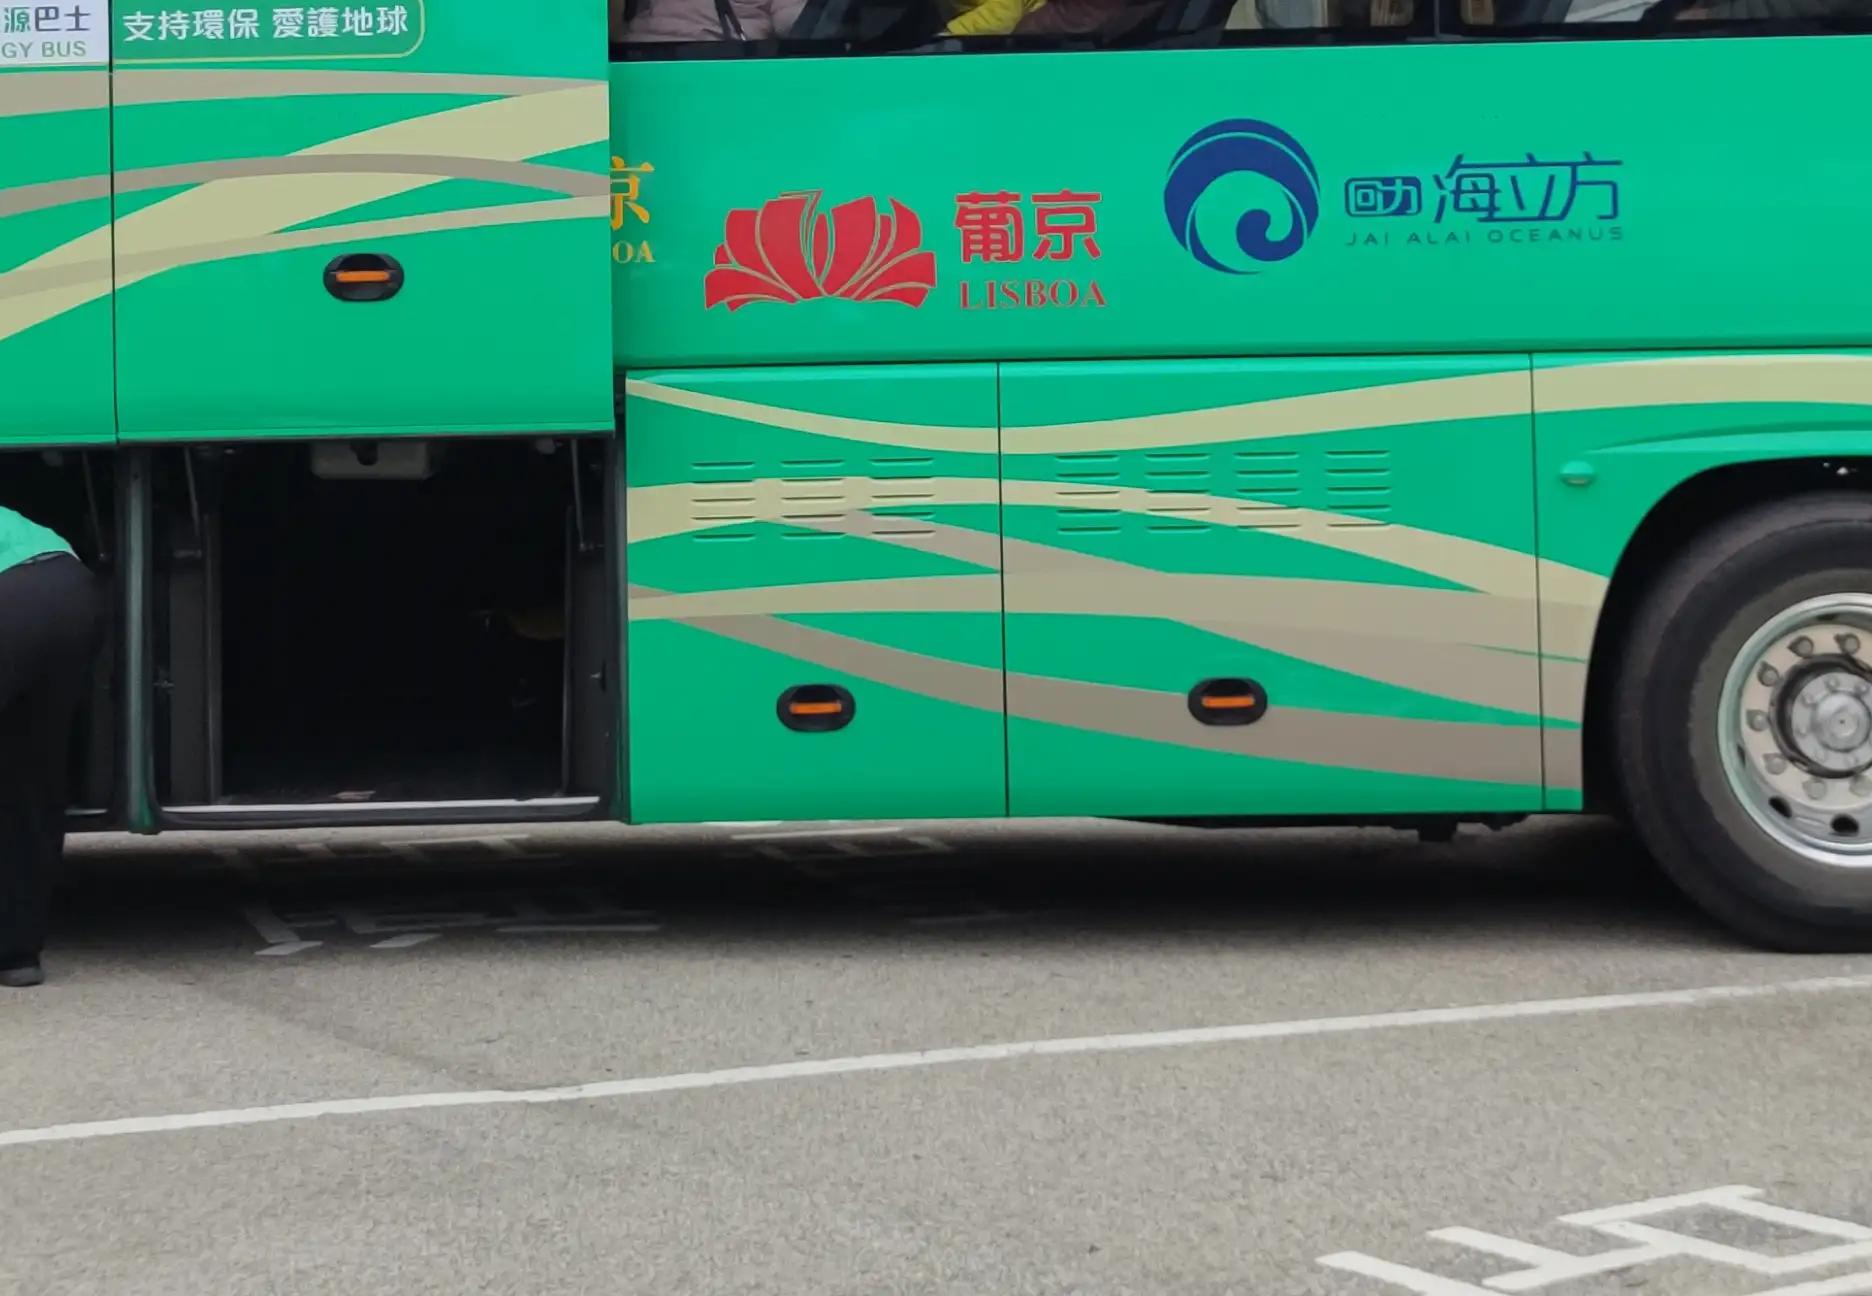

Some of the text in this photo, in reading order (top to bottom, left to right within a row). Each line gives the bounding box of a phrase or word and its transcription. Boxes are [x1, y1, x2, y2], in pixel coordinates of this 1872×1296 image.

[122, 6, 408, 42] 支持環保 愛護地球
[41, 40, 87, 58] BUS
[954, 188, 1103, 264] 葡京
[1345, 225, 1623, 247] JAI ALAI OCEANUS
[958, 279, 1108, 311] LISBOA
